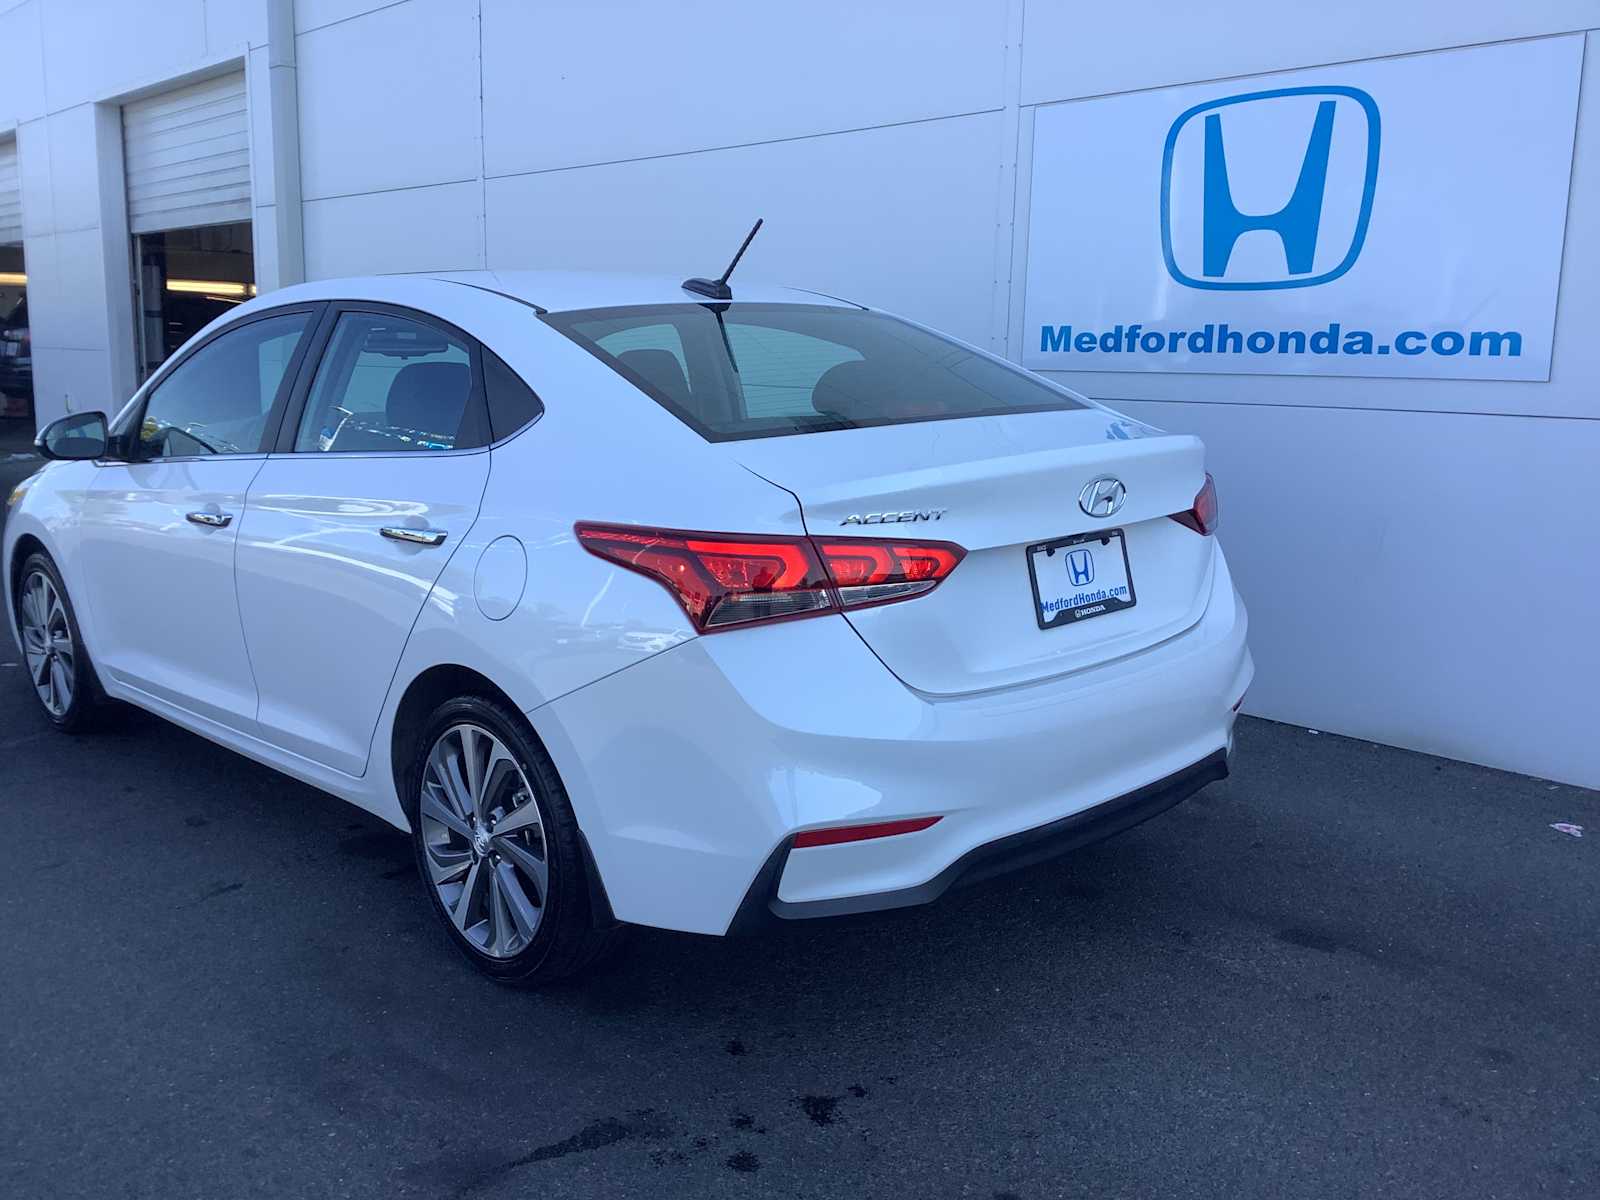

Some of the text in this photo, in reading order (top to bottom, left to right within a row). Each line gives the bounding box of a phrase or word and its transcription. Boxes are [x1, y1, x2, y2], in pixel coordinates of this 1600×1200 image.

[1039, 322, 1522, 358] Medfordhonda.com
[840, 508, 947, 526] ACCENT
[1041, 585, 1127, 613] MedfordHonda.com
[1081, 605, 1106, 616] HONDA
